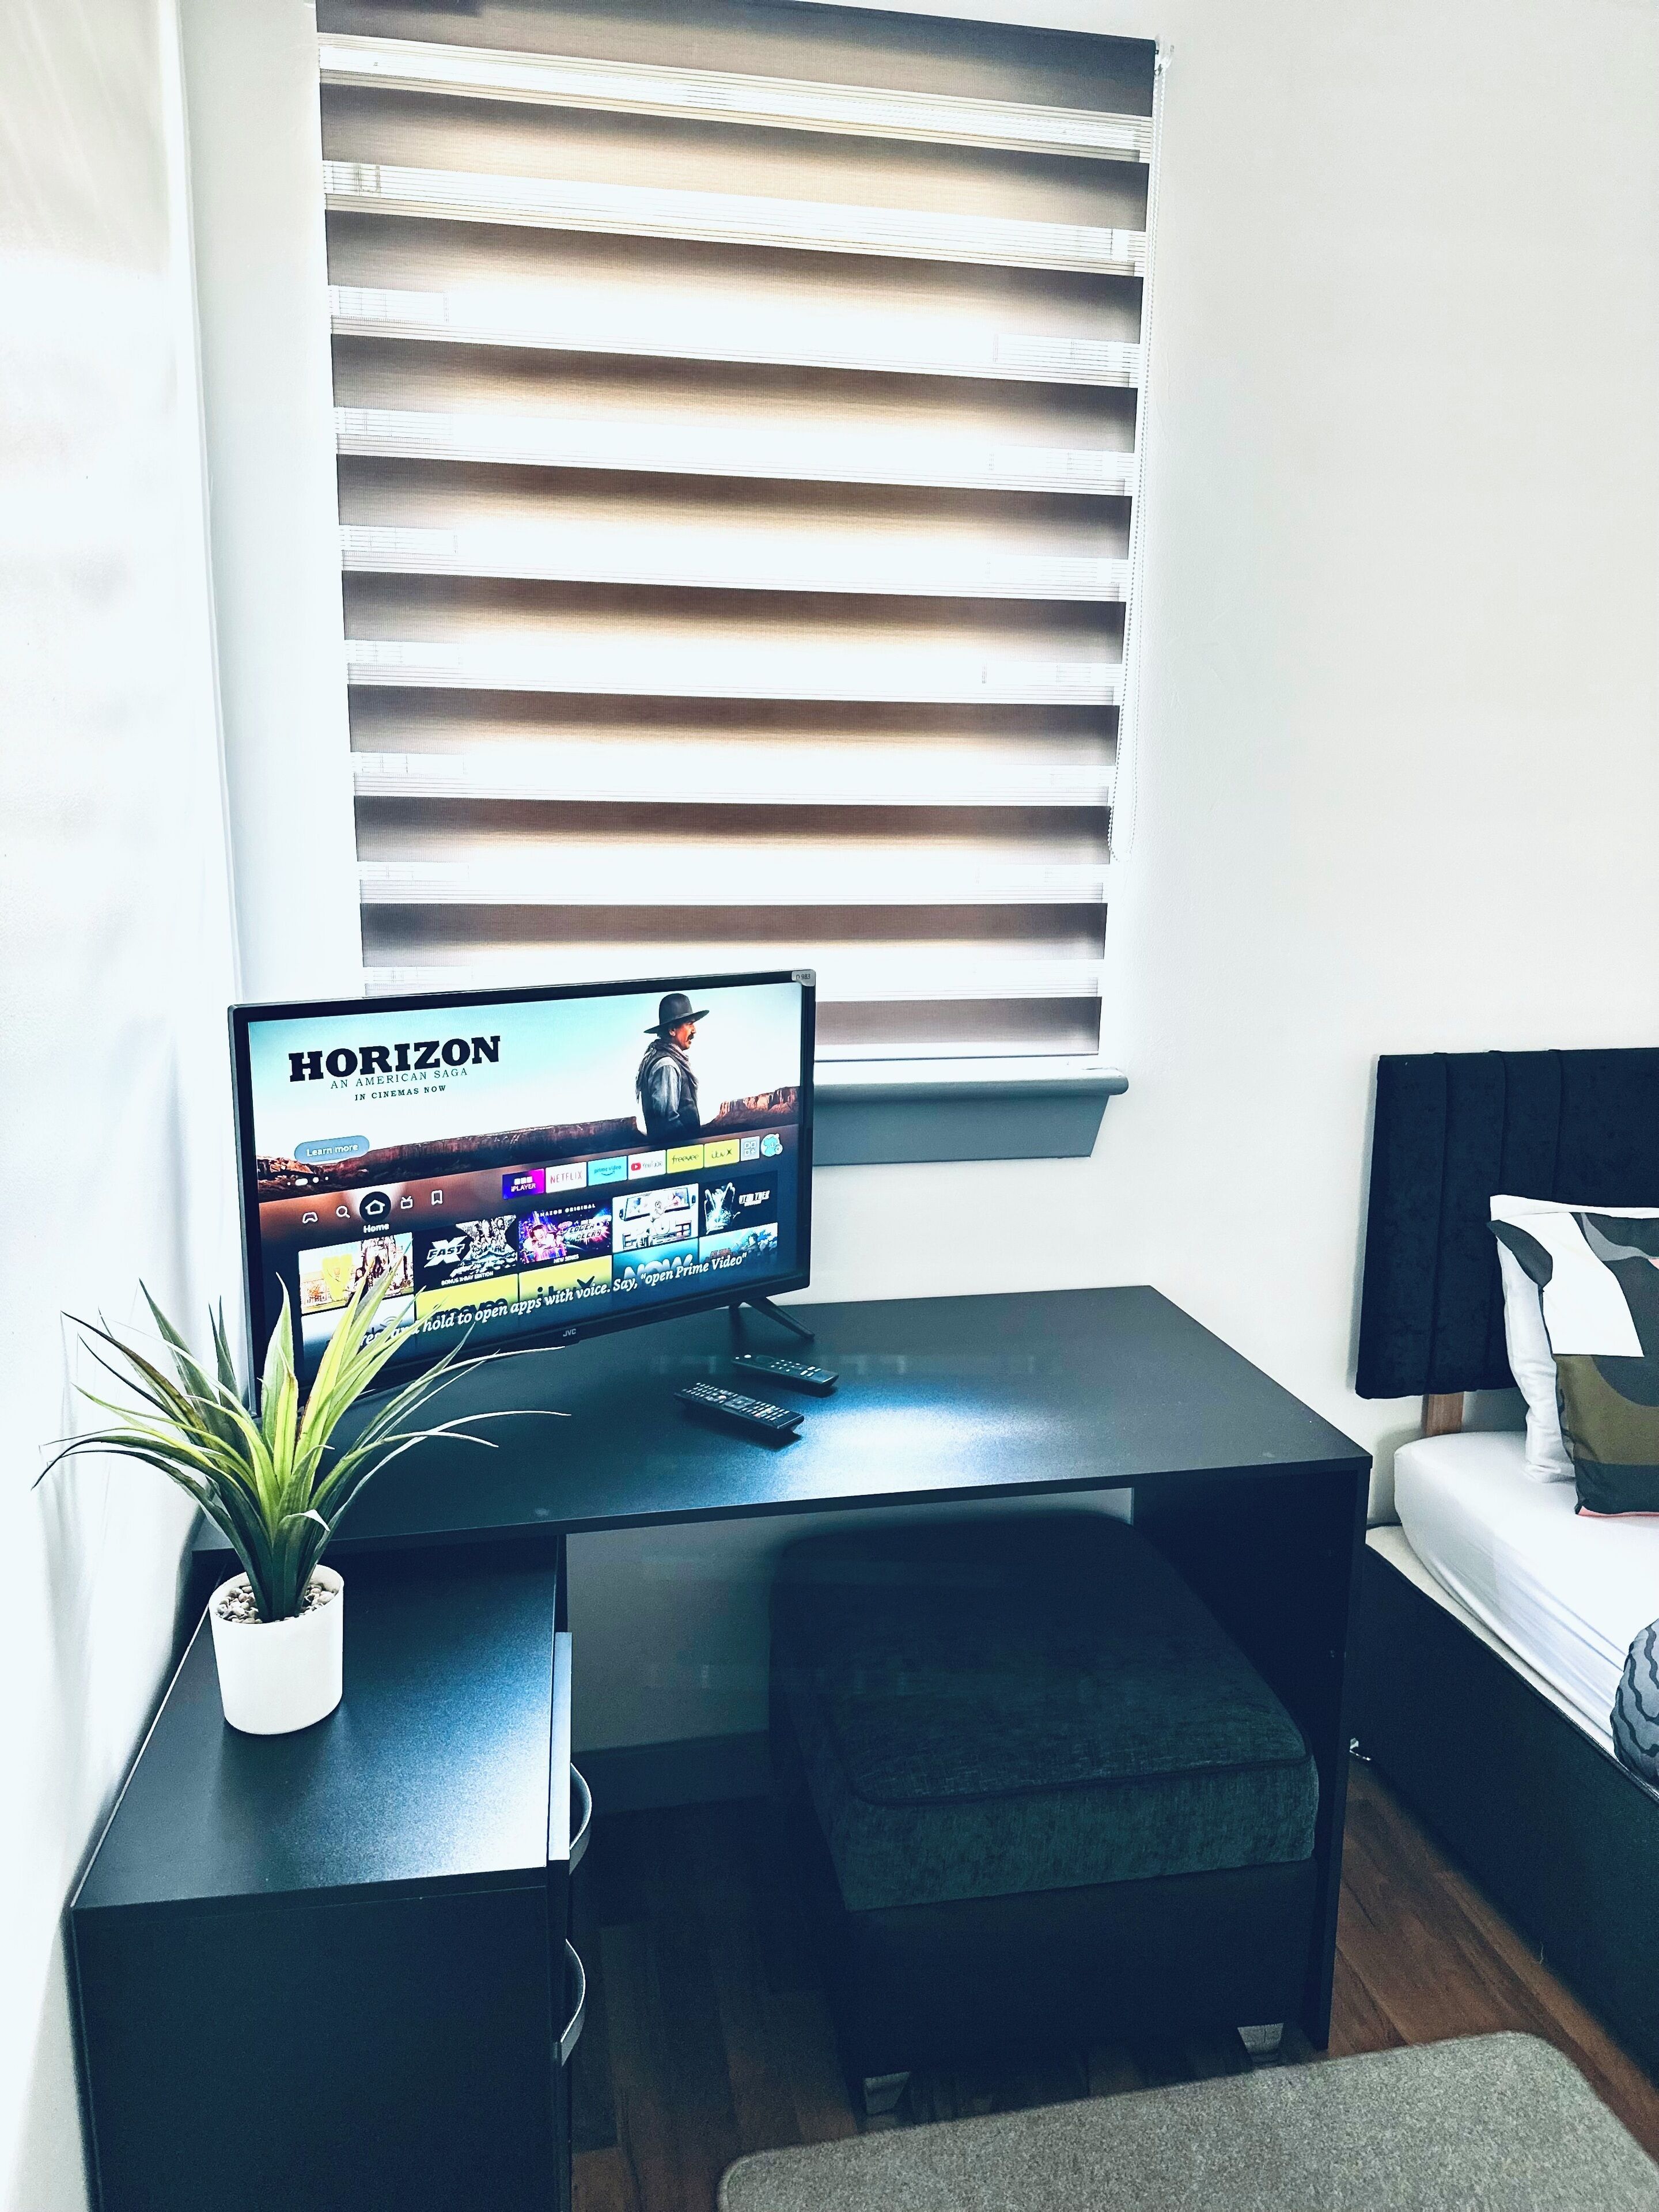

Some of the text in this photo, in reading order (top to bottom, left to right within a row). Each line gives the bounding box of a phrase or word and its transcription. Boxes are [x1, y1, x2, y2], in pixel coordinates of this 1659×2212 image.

[288, 1035, 501, 1082] HORIZON
[331, 1067, 468, 1089] AN AMERICAN SAGA
[372, 1088, 419, 1099] CINEMAS
[424, 1085, 446, 1093] NOW
[306, 1143, 358, 1157] Learn more
[671, 1154, 699, 1165] freevee
[550, 1171, 582, 1184] NETFLIX
[510, 1183, 536, 1193] iPLAYER
[363, 1224, 389, 1233] Home
[423, 1312, 454, 1332] hold
[457, 1312, 472, 1325] to
[475, 1304, 508, 1323] open
[510, 1297, 541, 1315] apps
[544, 1288, 574, 1306] with
[576, 1283, 611, 1299] voice.
[613, 1278, 638, 1292] Say,
[641, 1270, 673, 1287] "open
[675, 1263, 710, 1278] Prime
[711, 1251, 747, 1270] Video"
[563, 1328, 577, 1337] JVC
